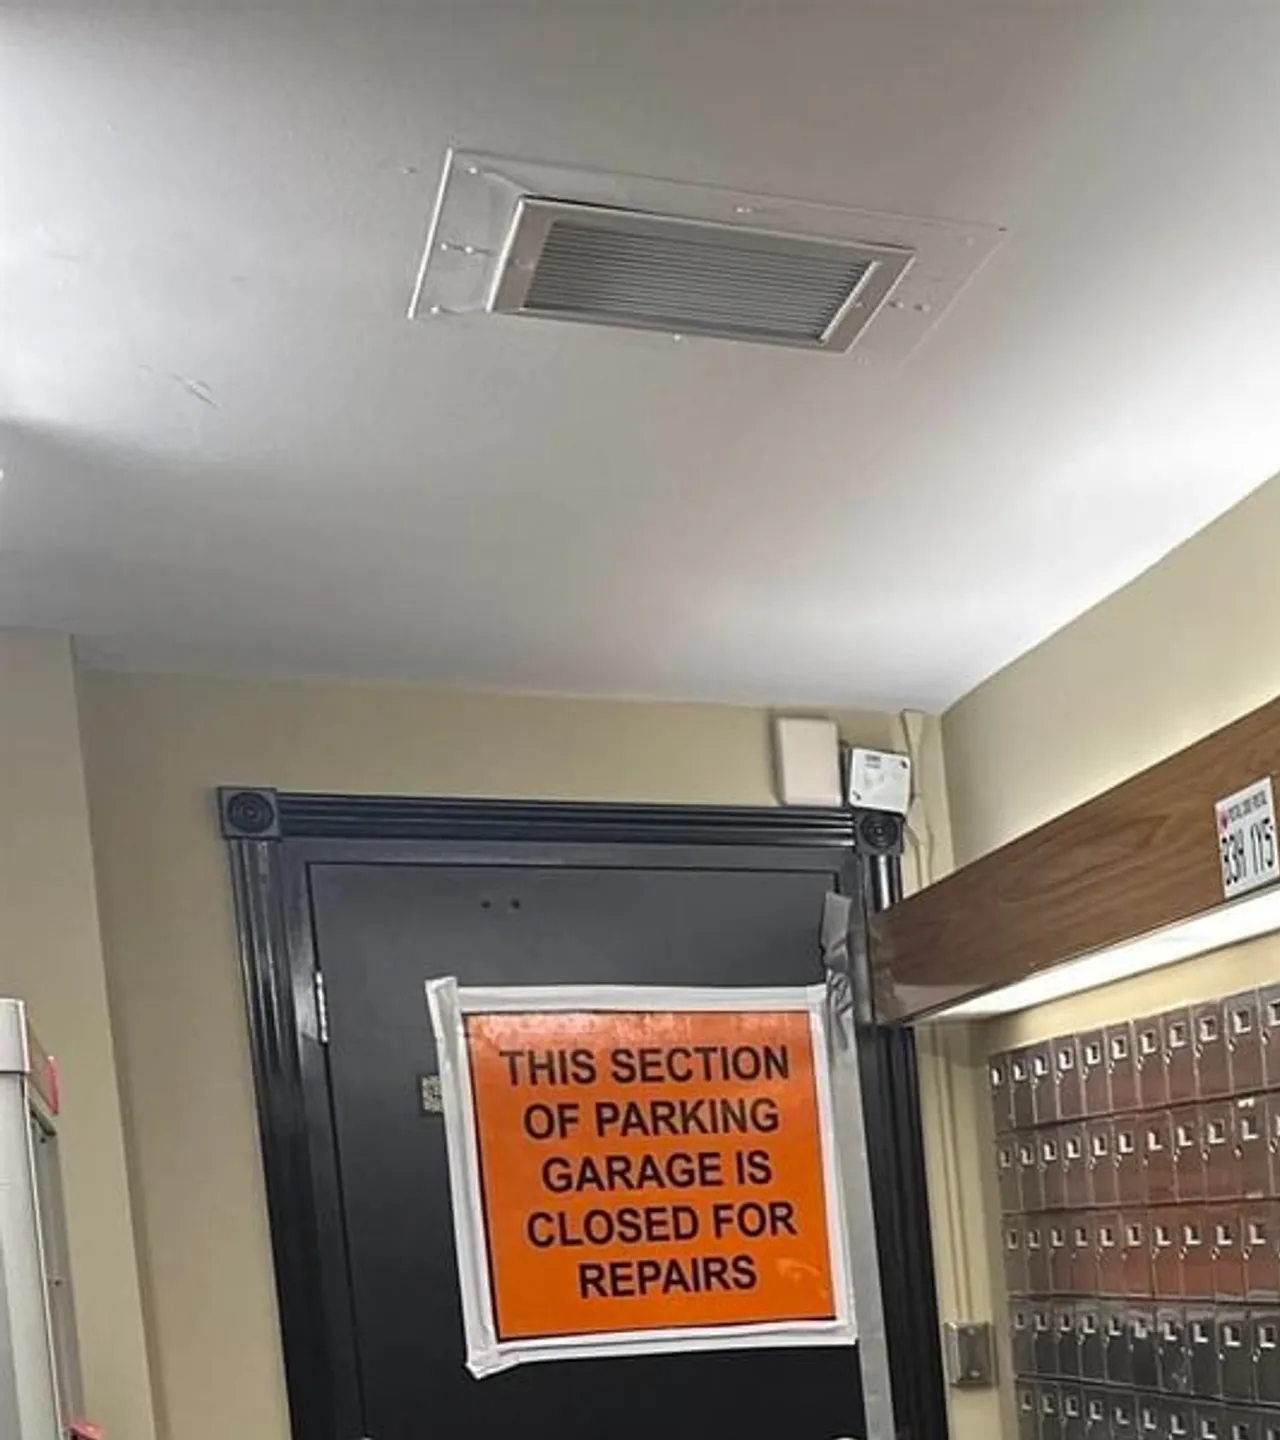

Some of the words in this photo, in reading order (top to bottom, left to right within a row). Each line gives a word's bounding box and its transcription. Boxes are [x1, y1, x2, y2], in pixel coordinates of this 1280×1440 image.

[500, 1049, 596, 1087] THIS
[612, 1045, 790, 1084] SECTION
[524, 1103, 580, 1140] OF
[595, 1098, 780, 1137] PARKING
[542, 1152, 722, 1192] GARAGE
[737, 1150, 772, 1186] IS
[527, 1206, 699, 1248] CLOSED
[713, 1201, 798, 1239] FOR
[578, 1255, 758, 1299] REPAIRS
